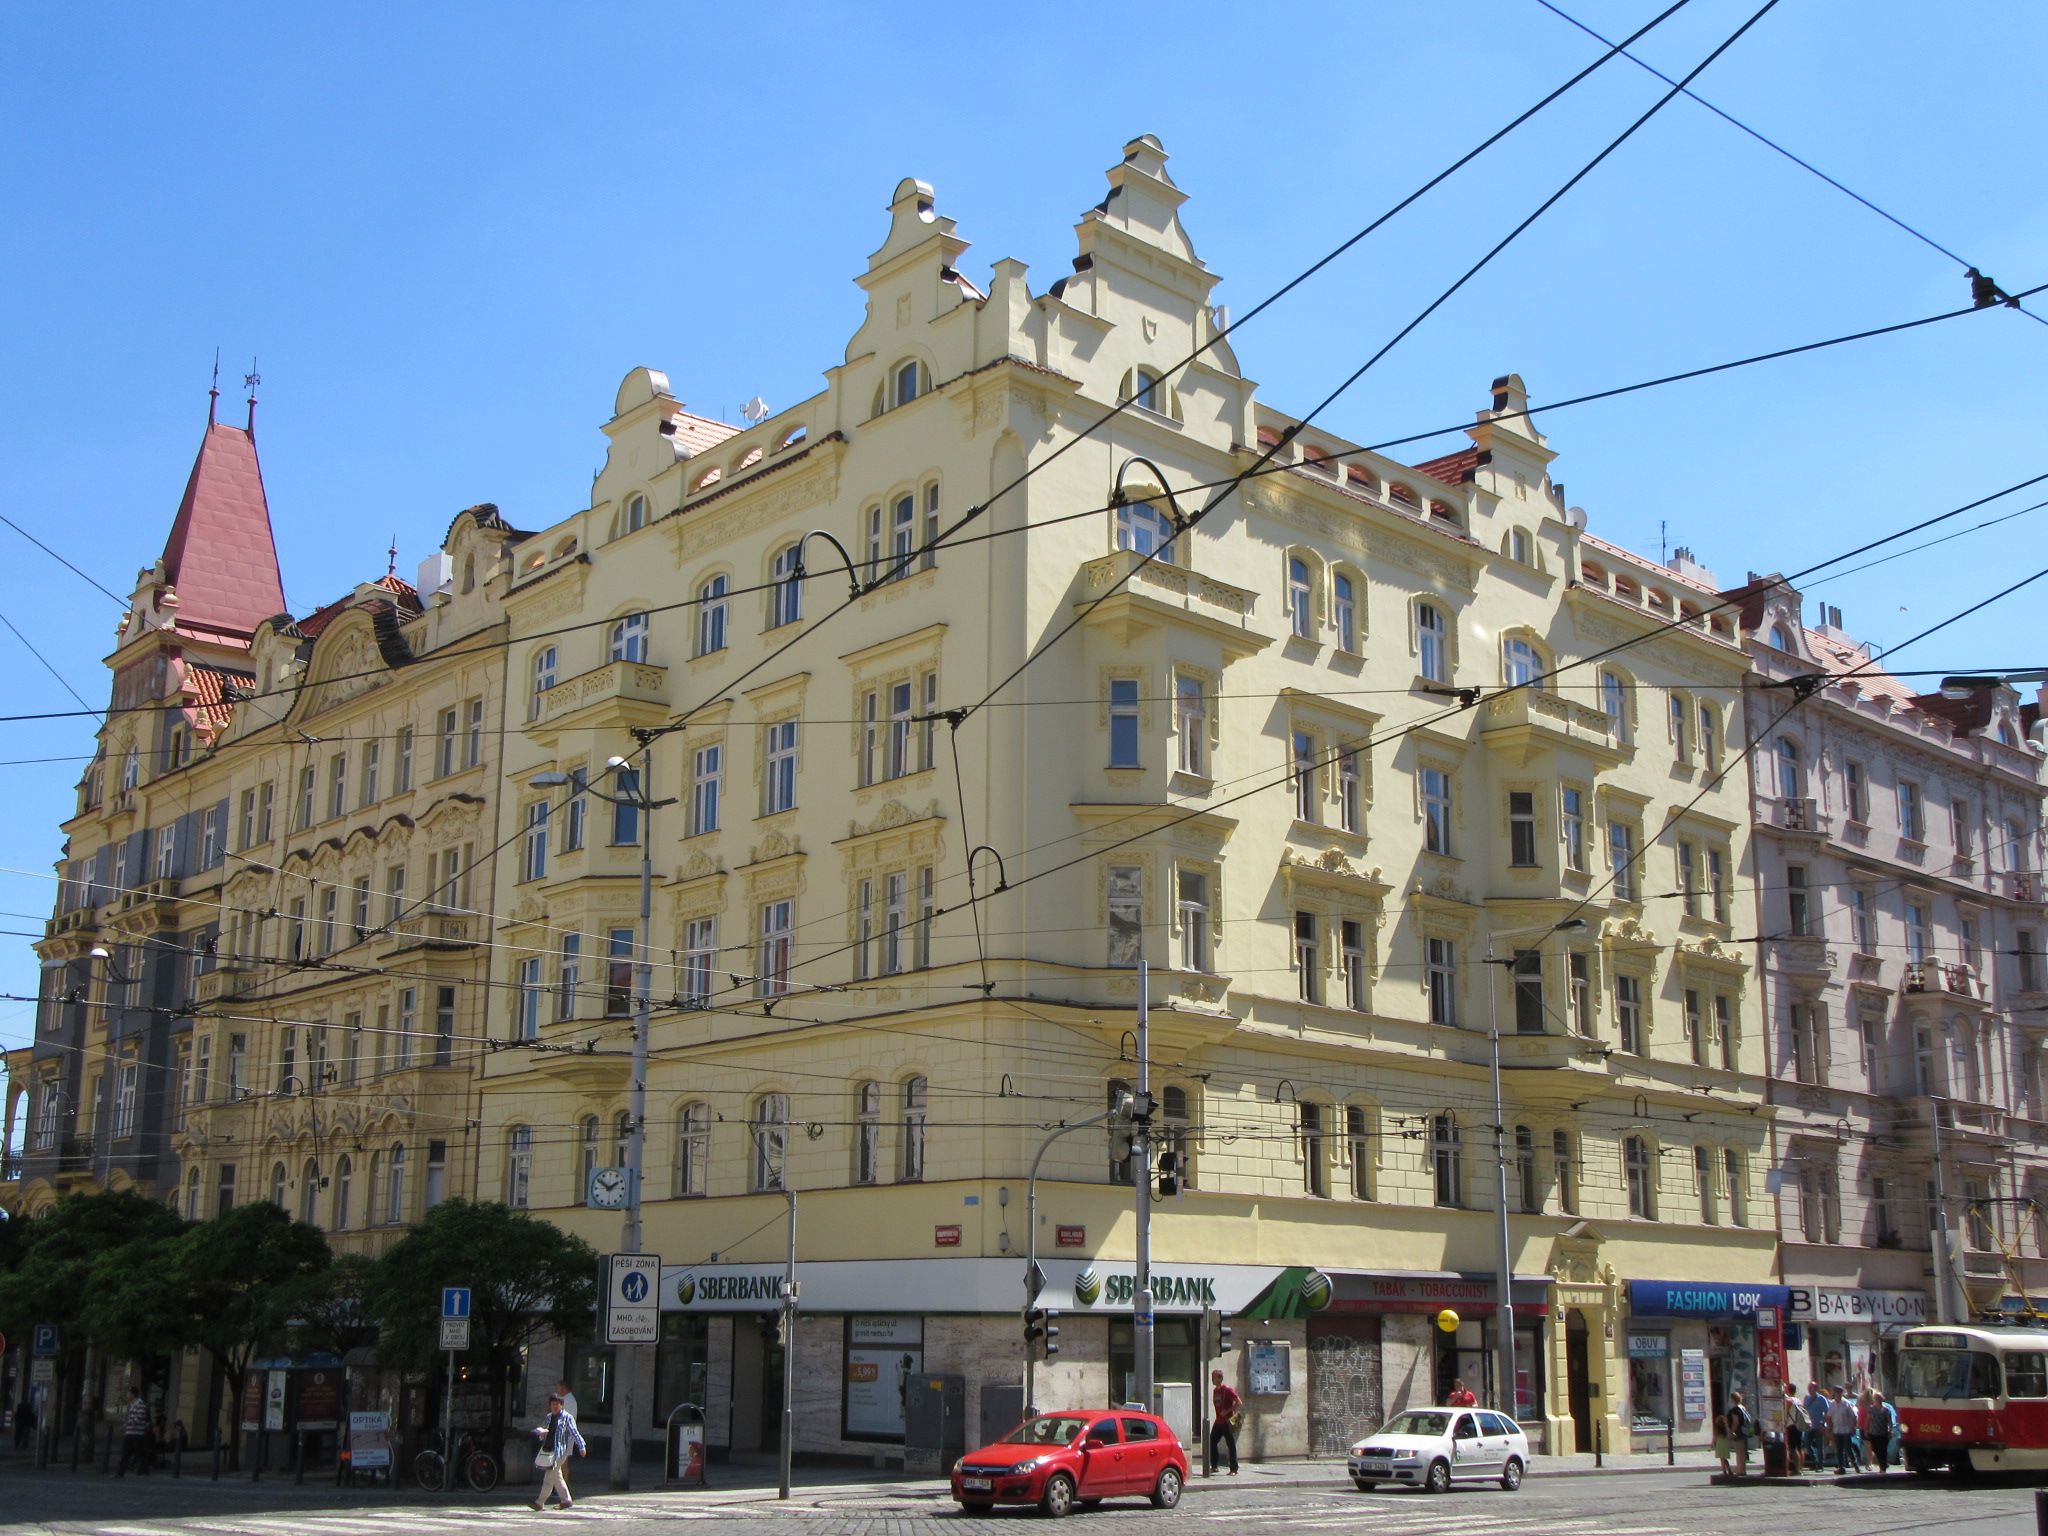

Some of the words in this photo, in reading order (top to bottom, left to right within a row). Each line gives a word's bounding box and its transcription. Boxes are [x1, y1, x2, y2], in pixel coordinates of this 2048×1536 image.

[615, 1258, 632, 1268] PĚŠÍ
[636, 1258, 656, 1268] ZÓNA
[698, 1275, 783, 1300] SBERBANK
[1372, 1280, 1407, 1297] TABÁK
[1419, 1282, 1489, 1298] TOBACCONIST
[1666, 1290, 1727, 1311] FASHION
[1791, 1290, 1812, 1312] B
[1635, 1337, 1658, 1349] OBUV
[352, 1416, 383, 1424] OPTIKA
